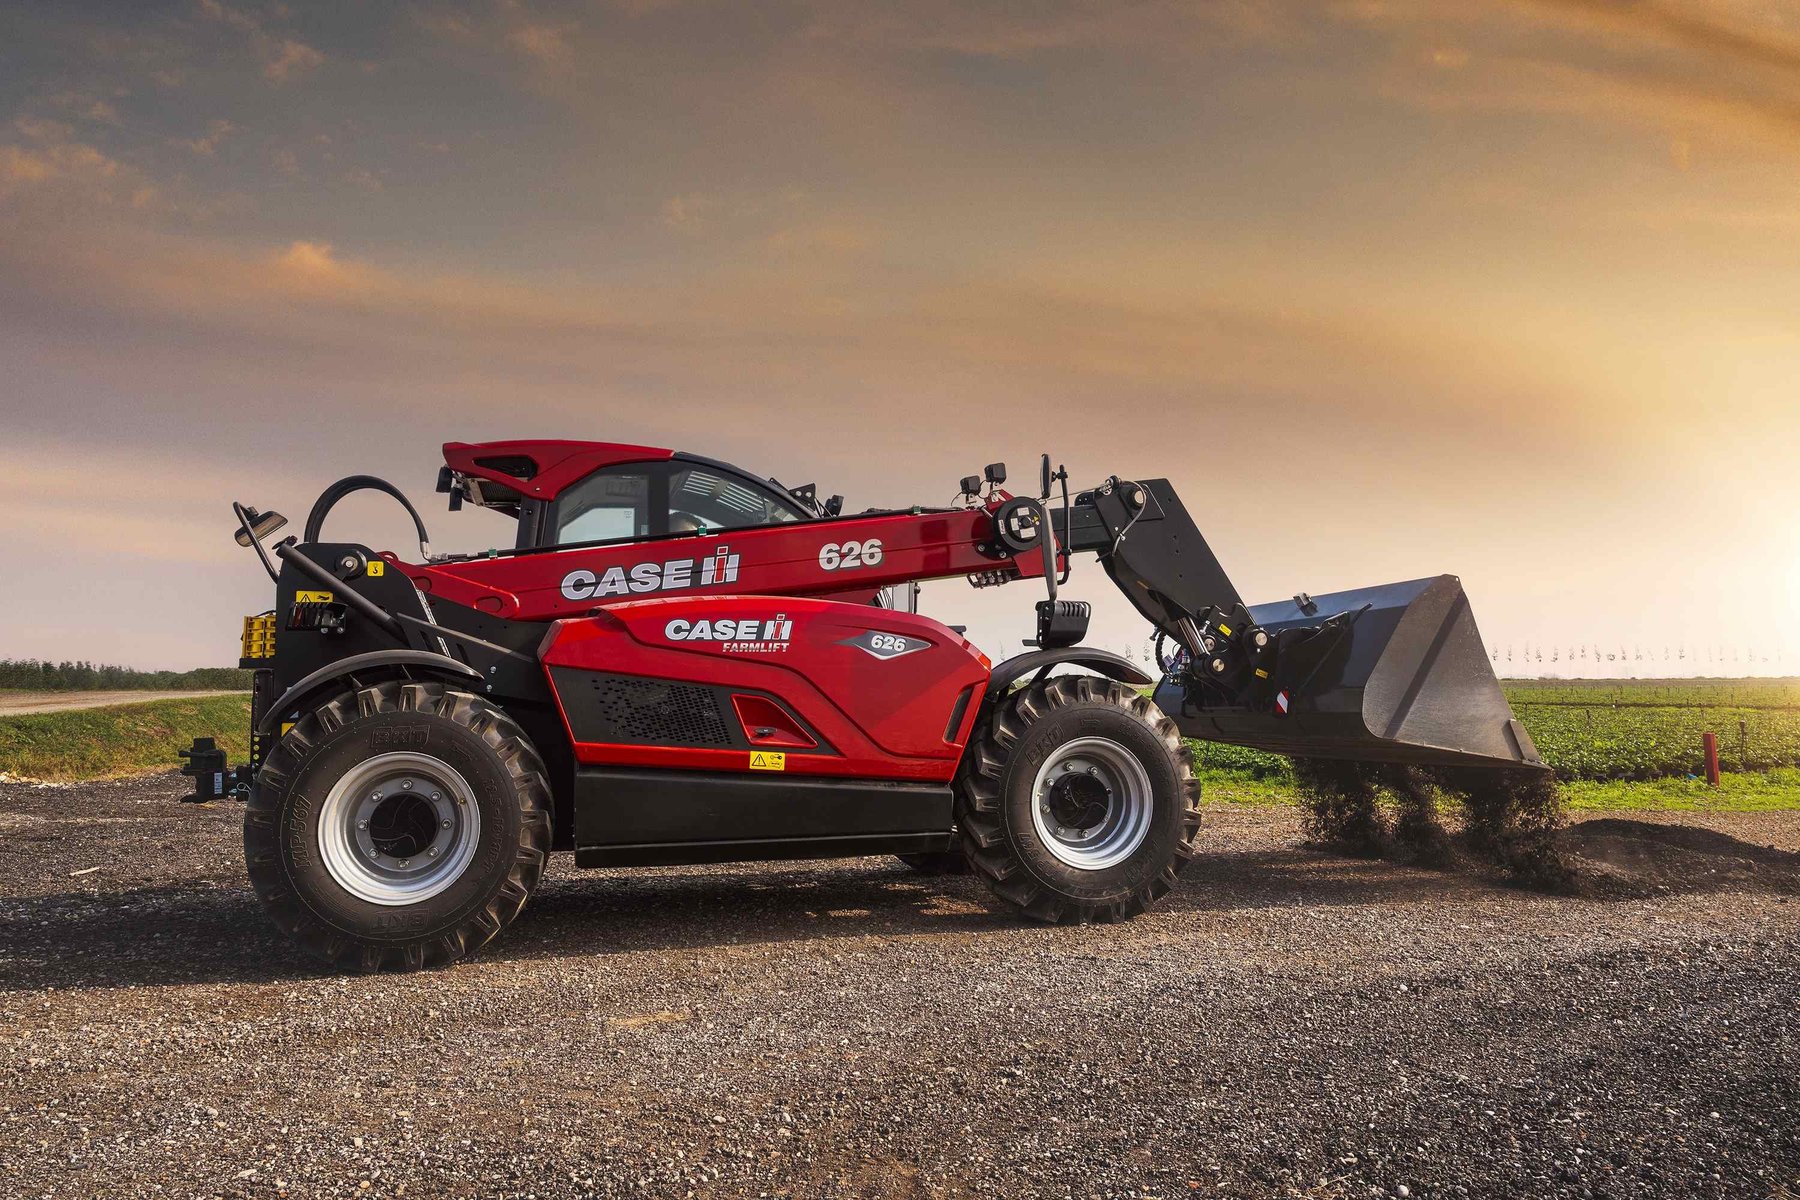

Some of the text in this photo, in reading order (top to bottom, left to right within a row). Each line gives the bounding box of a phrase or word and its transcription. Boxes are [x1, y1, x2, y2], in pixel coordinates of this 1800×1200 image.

[819, 538, 883, 571] 626
[561, 558, 694, 600] CASE
[664, 619, 760, 641] CASE
[722, 642, 790, 653] FARMLIFT
[870, 634, 907, 652] 626
[370, 724, 431, 748] BKT
